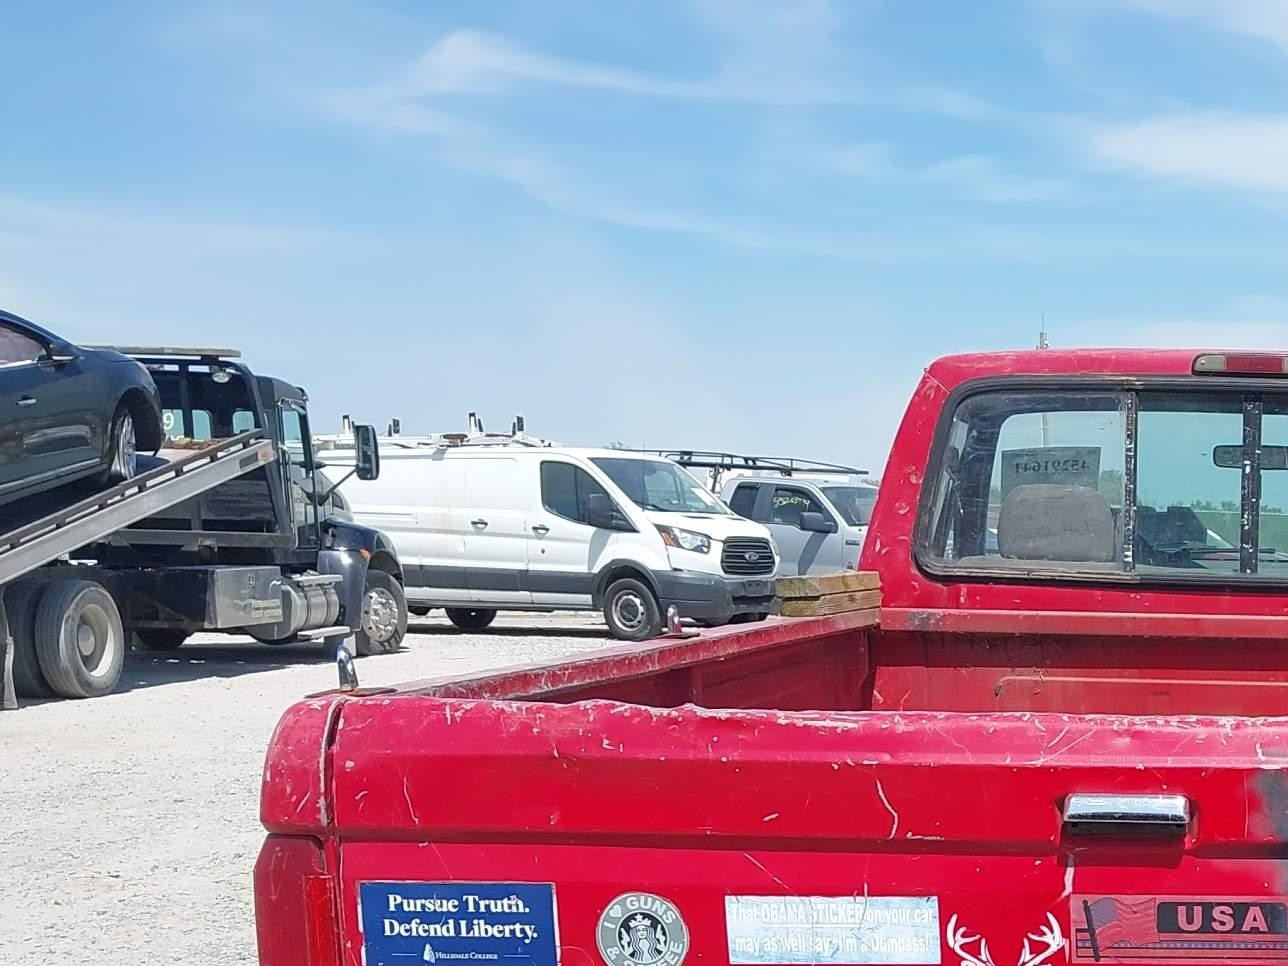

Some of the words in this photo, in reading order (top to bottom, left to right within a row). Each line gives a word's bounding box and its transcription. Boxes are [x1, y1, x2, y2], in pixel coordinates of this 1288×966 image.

[387, 893, 459, 913] Pursue
[463, 894, 530, 914] Truth.
[603, 921, 616, 929] I
[626, 895, 676, 924] GUNS
[731, 903, 760, 921] That
[761, 902, 806, 922] OBAMA
[808, 902, 864, 922] STICKER
[865, 908, 881, 921] on
[885, 907, 911, 927] your
[1177, 905, 1269, 932] USA
[383, 918, 456, 937] Defend
[459, 919, 538, 944] Liberty.
[435, 951, 469, 960] HILLSDALE
[470, 951, 499, 960] COLLEGE
[606, 946, 620, 960] &
[735, 936, 760, 956] may
[764, 937, 778, 952] as
